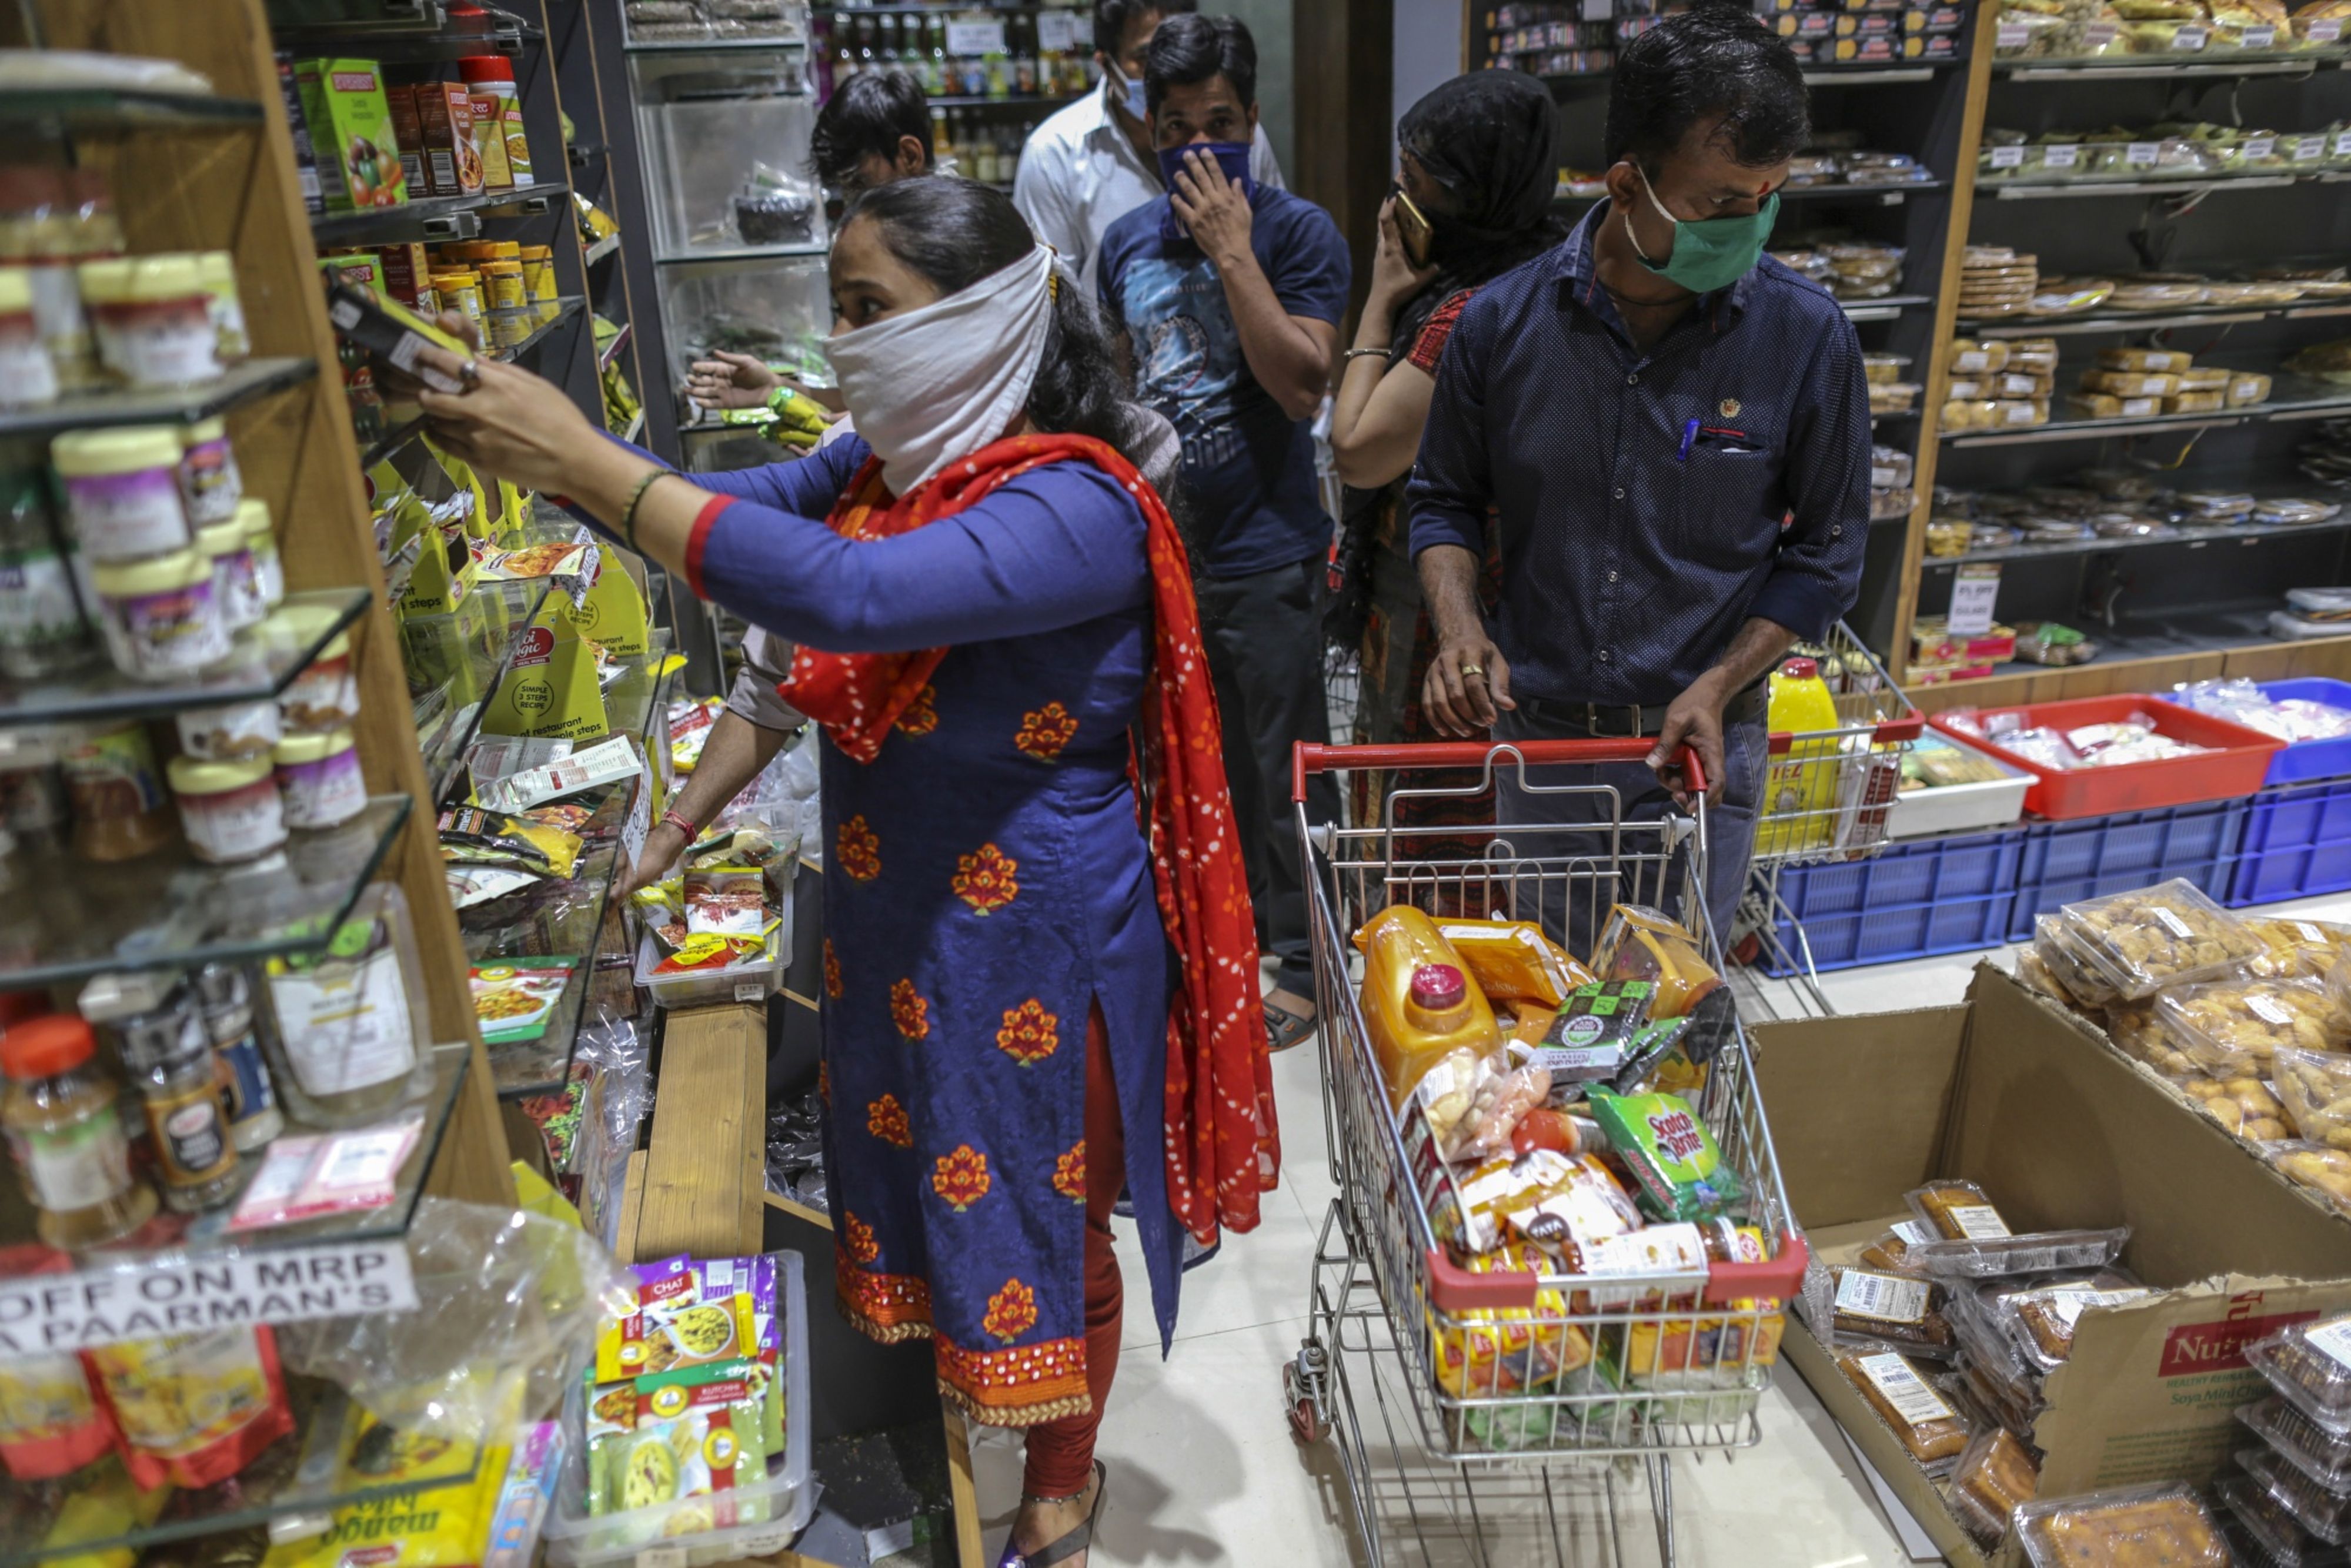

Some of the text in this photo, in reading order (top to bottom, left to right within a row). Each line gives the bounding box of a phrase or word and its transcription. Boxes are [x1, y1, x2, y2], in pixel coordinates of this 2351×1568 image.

[409, 597, 441, 609] steps
[592, 636, 624, 645] taurant
[619, 643, 641, 653] steps
[522, 686, 548, 694] SIMPLE
[532, 716, 582, 736] restaurant
[546, 723, 602, 739] imple steps
[1648, 1111, 1694, 1139] Scotch-
[1667, 1132, 1704, 1157] Brite
[1531, 1219, 1564, 1238] TATA
[140, 1265, 233, 1302] ON
[256, 1252, 386, 1289] MRP
[653, 1277, 684, 1295] CHAT
[41, 1283, 392, 1347] PAARMAN'S
[2167, 1376, 2208, 1388] HEALTHY
[2170, 1393, 2202, 1406] Soya
[2204, 1388, 2235, 1400] Mini
